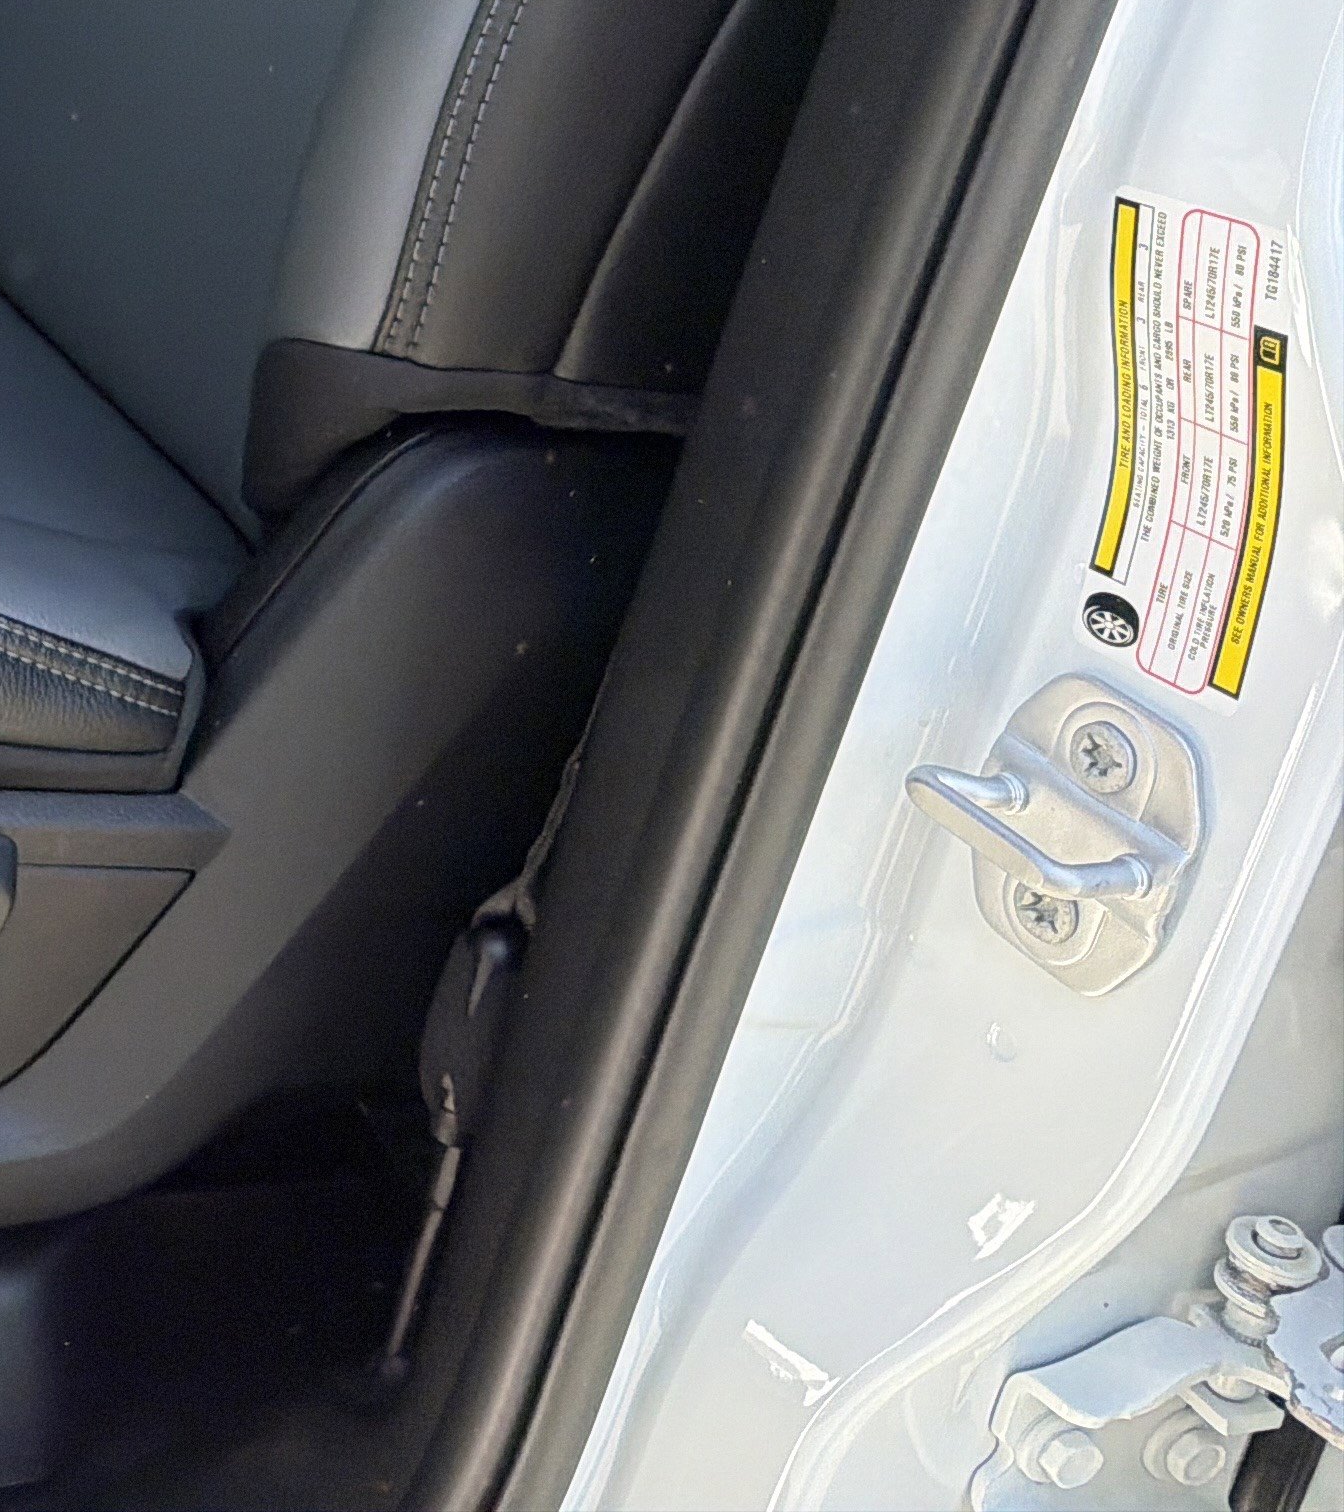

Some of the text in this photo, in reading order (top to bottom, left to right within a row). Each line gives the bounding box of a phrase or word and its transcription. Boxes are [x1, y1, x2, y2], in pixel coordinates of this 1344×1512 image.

[1139, 243, 1148, 251] 3
[1236, 244, 1247, 262] PSI
[1235, 264, 1245, 276] 80
[1265, 239, 1284, 301] TG184417
[1231, 309, 1241, 328] 550
[1230, 353, 1240, 370] PSI
[1117, 300, 1132, 468] TIRE AND LOADING INFORMATION
[1141, 212, 1168, 542] THE COMBINED WEIGHT OF OCCUPANTS AND CARGO SHOULD NEVER EXCEED
[1166, 378, 1174, 390] OR
[1156, 280, 1192, 604] TIRE FRONT REAR SPARE
[1168, 247, 1220, 650] ORIGINAL TIRE SIZE LT245/70R17E LT245/70R17E LT245/70R17E
[1228, 457, 1238, 473] PSI
[1227, 475, 1237, 488] 75
[1231, 402, 1272, 644] SEE OWNERS MANUAL FOR ADDITIONAL INFORMATION
[1199, 573, 1215, 616] INFLATION
[1194, 616, 1205, 635] TIRE
[1200, 605, 1217, 649] PRESSURE
[1188, 637, 1200, 661] COLD
